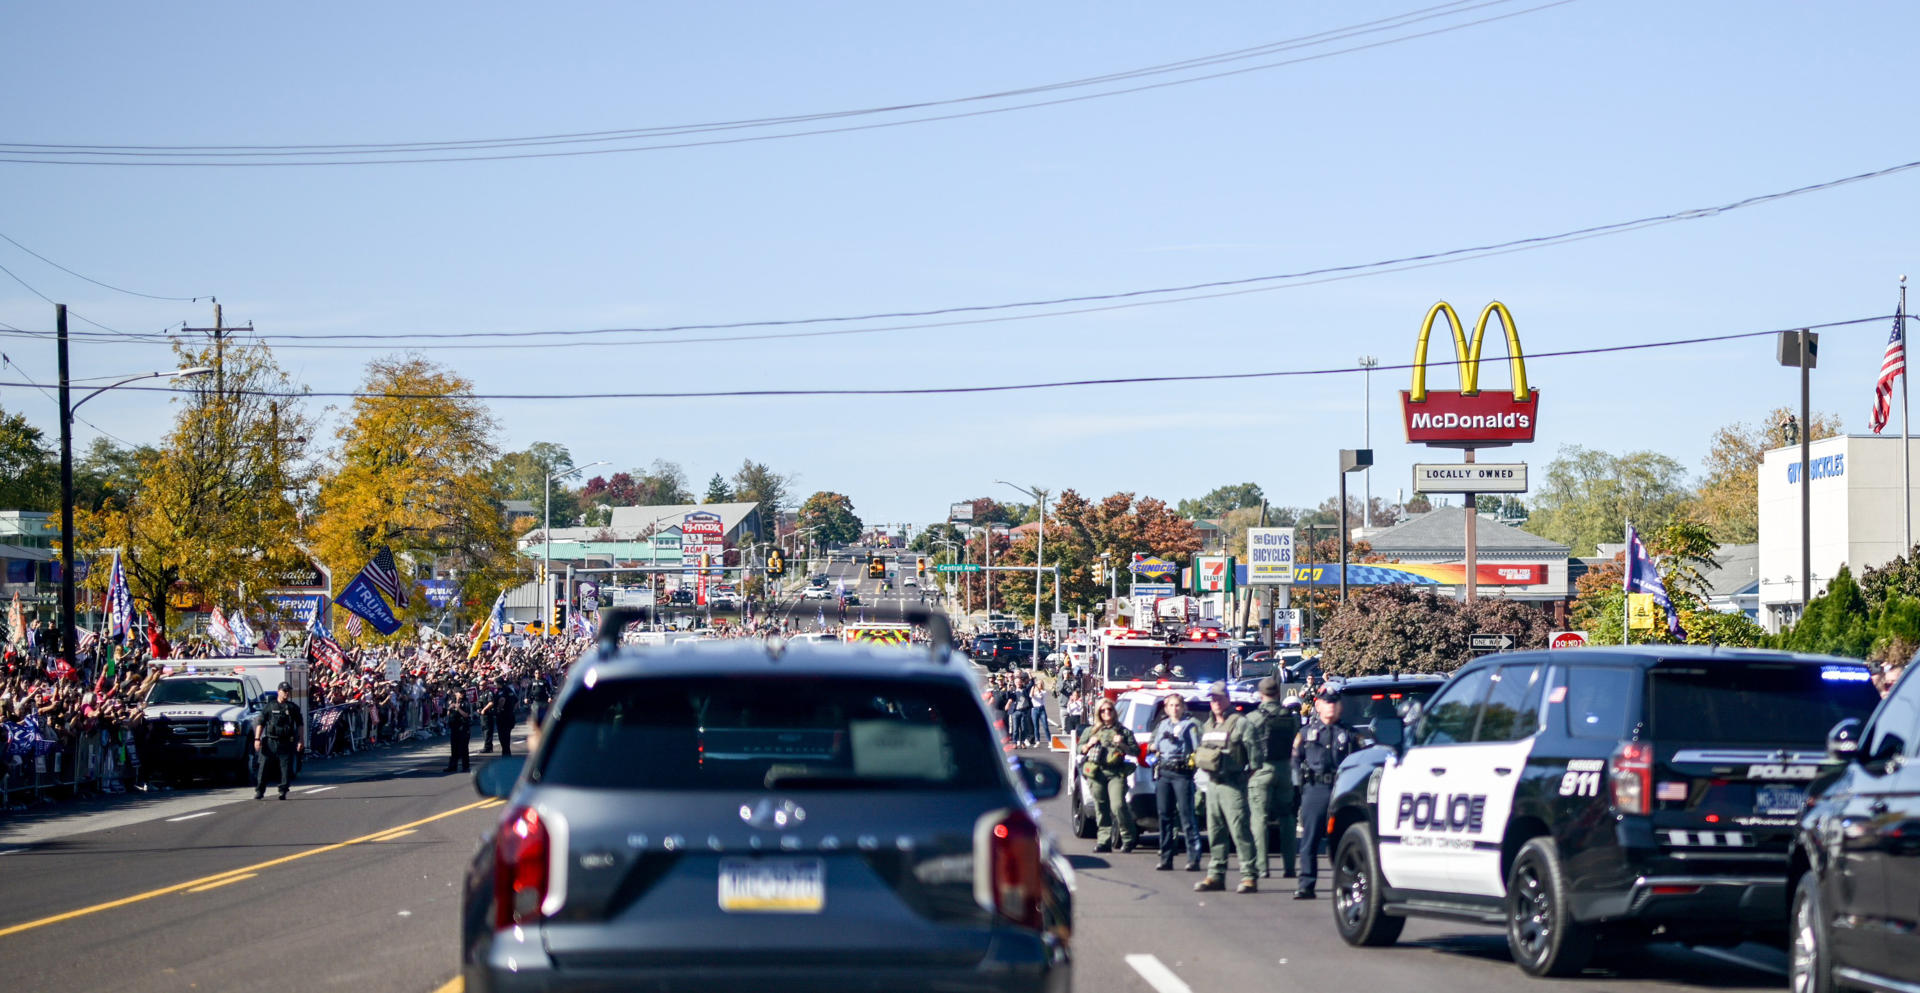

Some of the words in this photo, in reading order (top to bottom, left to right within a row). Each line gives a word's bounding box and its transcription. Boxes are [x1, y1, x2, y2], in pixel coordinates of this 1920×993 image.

[1411, 412, 1530, 429] McDonald's
[1426, 469, 1471, 479] LOCALLY
[1479, 469, 1514, 479] OWNED
[1810, 453, 1844, 481] BICYCLES
[1263, 533, 1290, 546] GUY'S
[1253, 548, 1291, 562] BICYCLES
[1135, 563, 1173, 573] SUNOCO
[1205, 562, 1224, 590] 7
[355, 582, 393, 624] TRUMP
[1555, 640, 1566, 648] DO
[1746, 764, 1818, 779] POLICE
[1558, 771, 1601, 797] 911
[1395, 792, 1487, 834] POLICE
